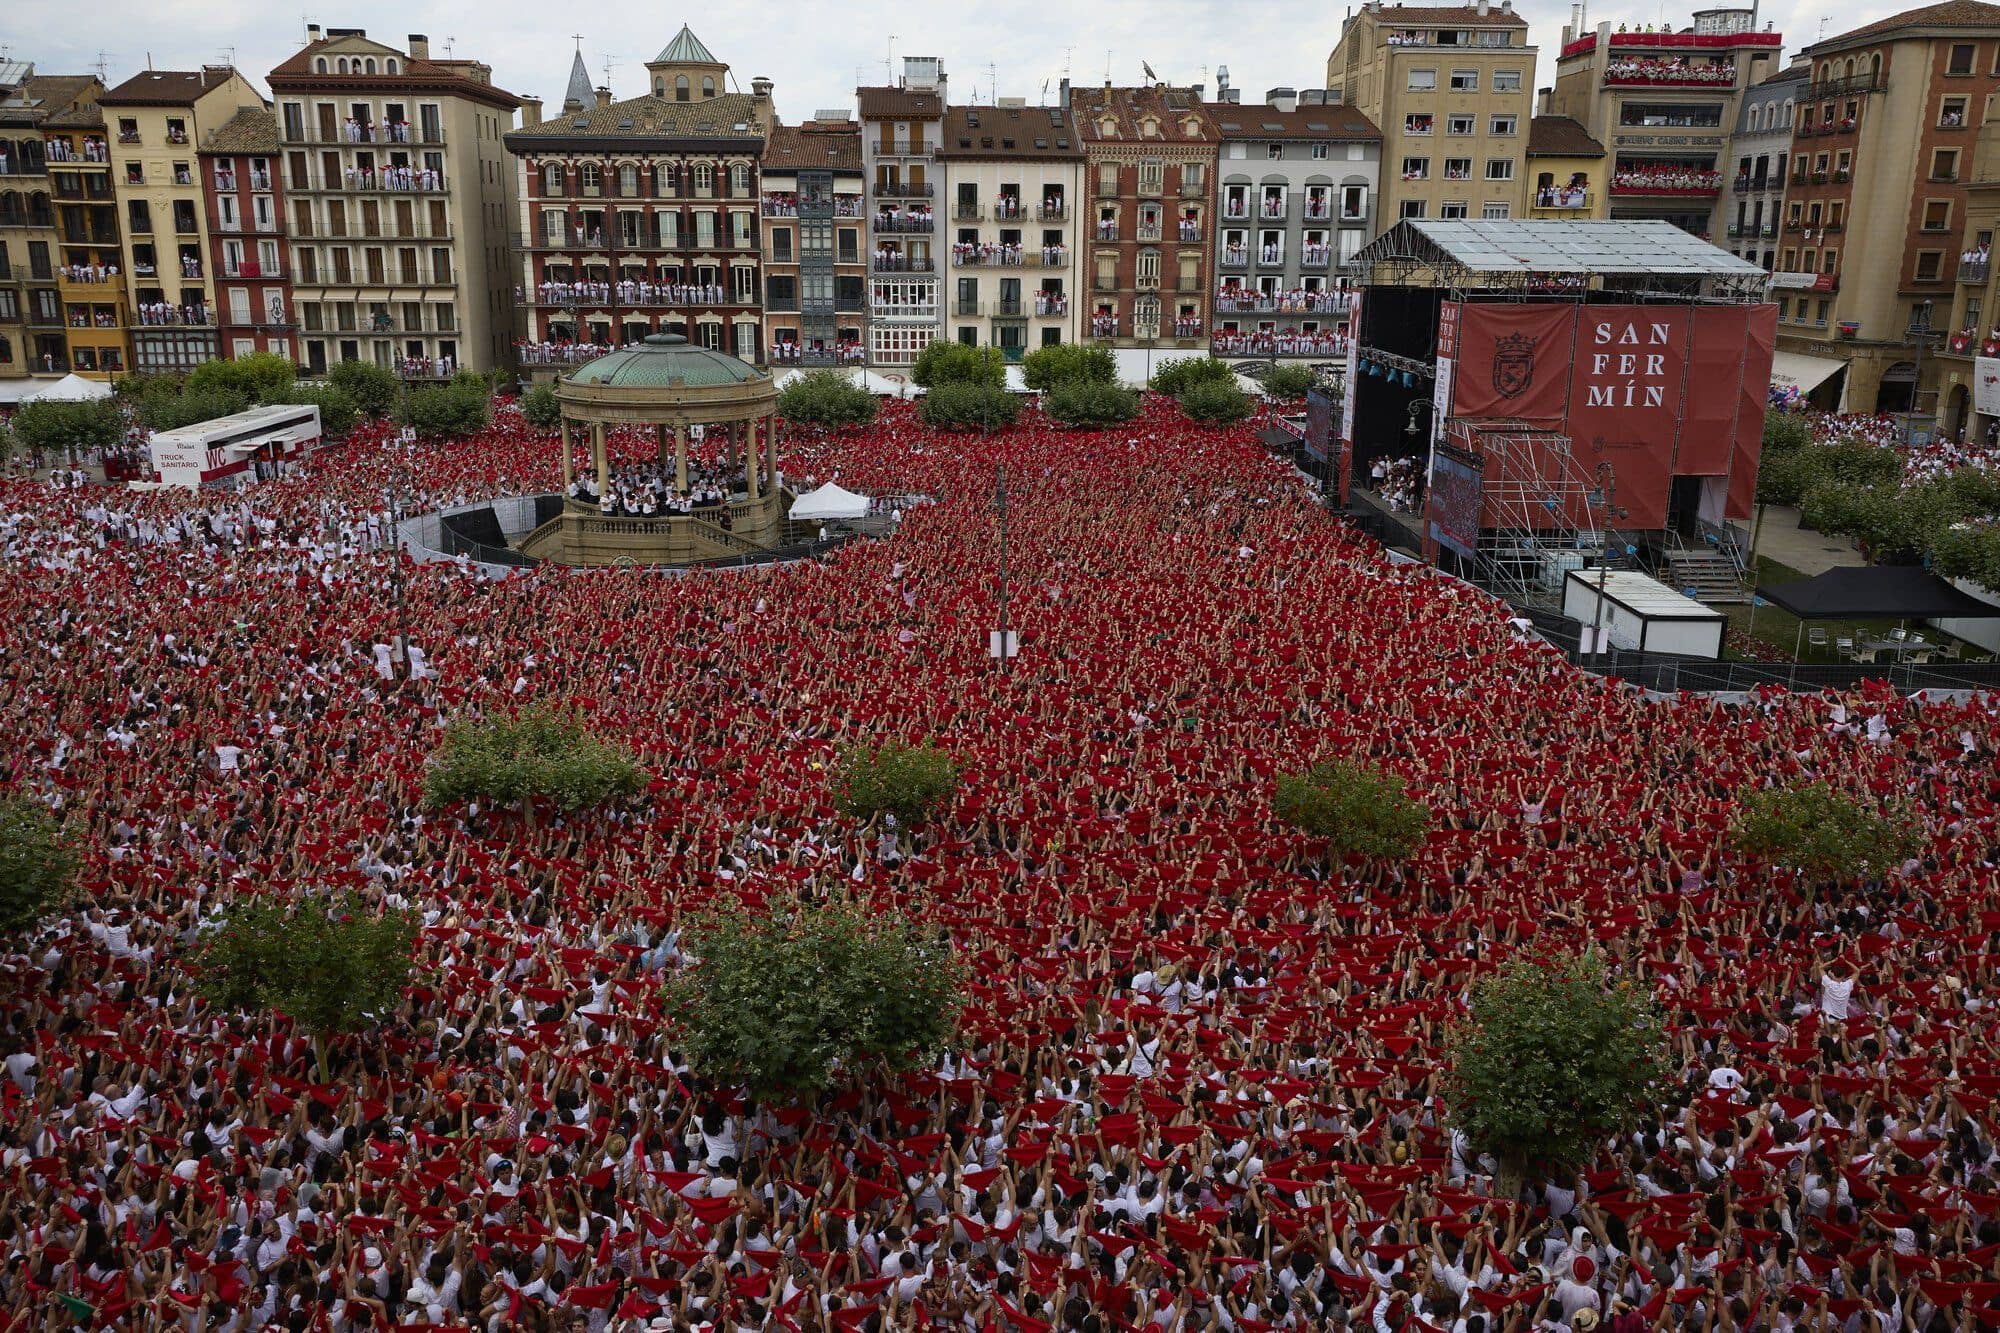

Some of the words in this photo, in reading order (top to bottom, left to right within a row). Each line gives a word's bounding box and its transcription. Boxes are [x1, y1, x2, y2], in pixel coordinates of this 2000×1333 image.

[1440, 307, 1456, 321] SAN
[1595, 322, 1670, 345] SAN
[1592, 353, 1665, 375] FER
[1585, 379, 1665, 407] MÍN
[205, 447, 227, 470] WC
